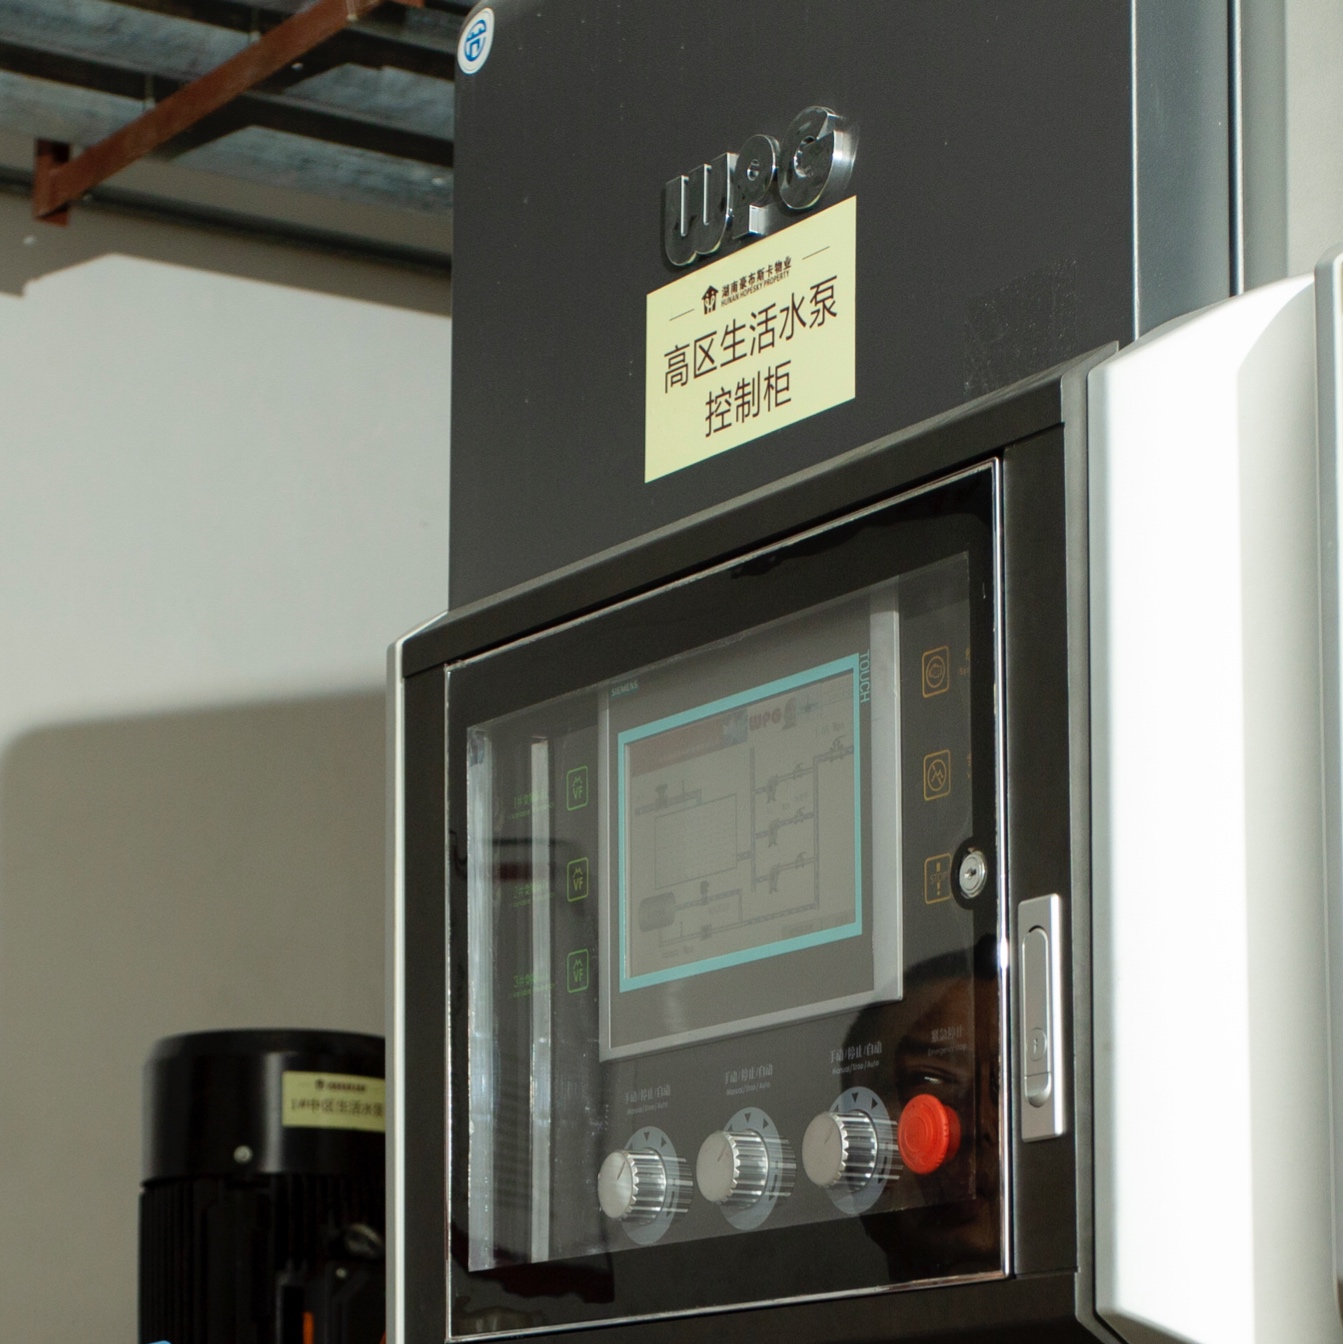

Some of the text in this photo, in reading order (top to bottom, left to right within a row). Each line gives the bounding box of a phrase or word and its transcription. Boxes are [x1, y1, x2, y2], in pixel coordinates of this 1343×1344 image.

[721, 270, 789, 307] HUNAN HOPESKY PROPERTY
[722, 256, 791, 298] 湖南豪布斯卡物业
[664, 276, 838, 393] 高区生活水泵
[705, 360, 792, 437] 控制柜
[611, 680, 639, 697] SIEMENS
[860, 649, 870, 703] TOUCH
